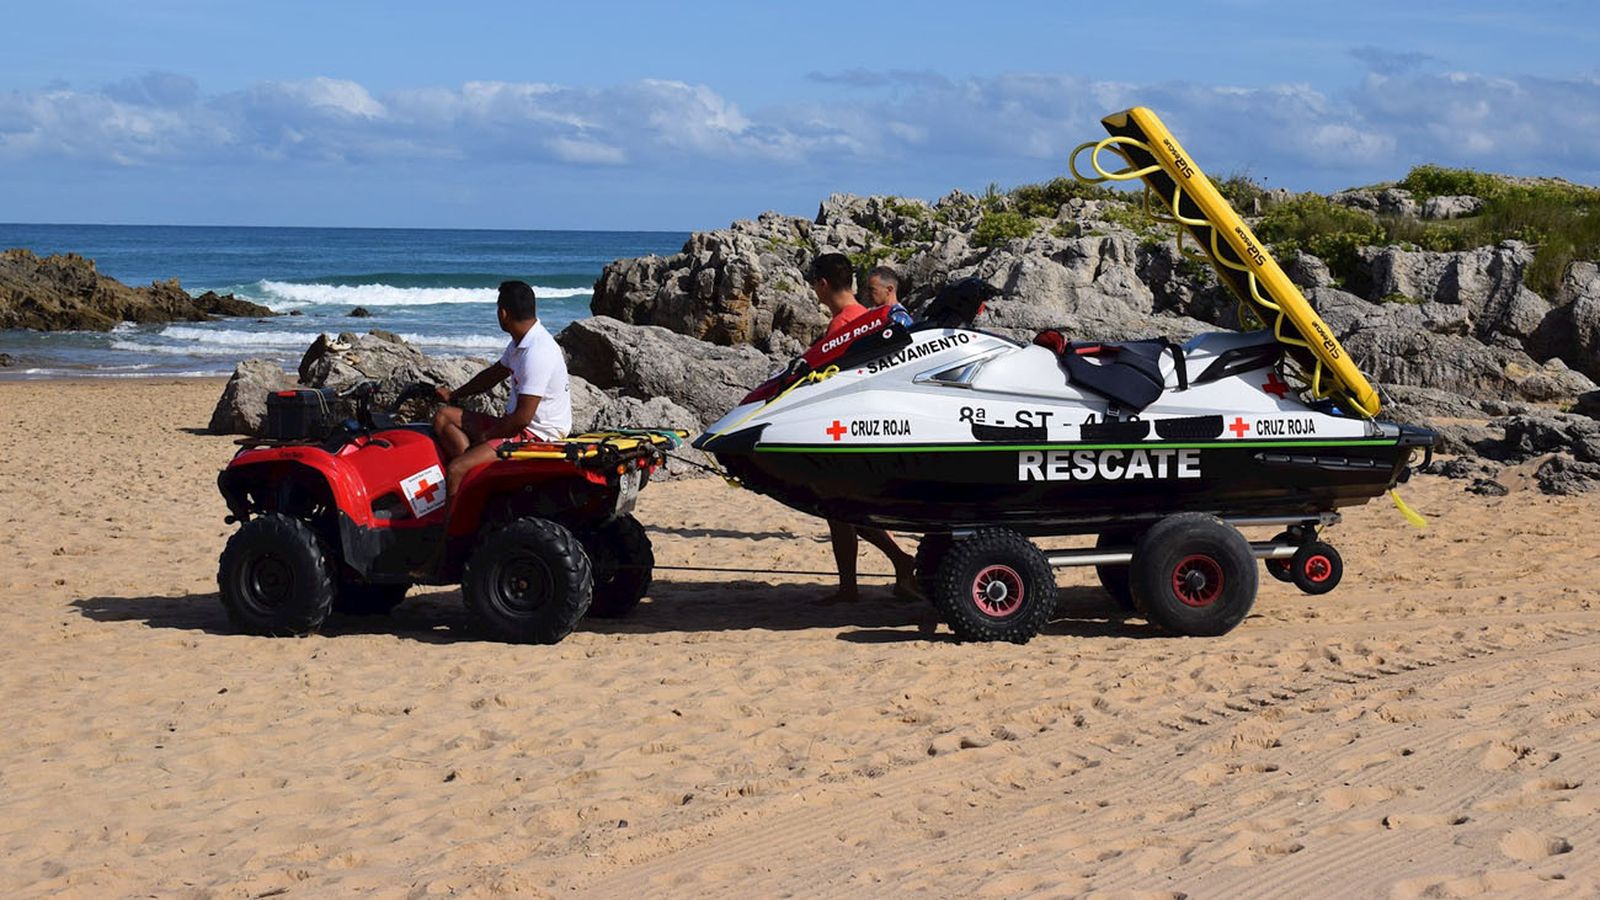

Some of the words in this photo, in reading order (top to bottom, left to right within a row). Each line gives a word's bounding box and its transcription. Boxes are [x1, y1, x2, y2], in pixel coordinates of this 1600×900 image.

[821, 333, 851, 353] CRUZ
[853, 319, 882, 338] ROJA
[866, 333, 970, 374] SALVAMENTO
[851, 420, 880, 436] CRUZ
[883, 419, 911, 436] ROJA
[1256, 419, 1285, 436] CRUZ
[1288, 418, 1316, 435] ROJA
[1018, 449, 1202, 482] RESCATE
